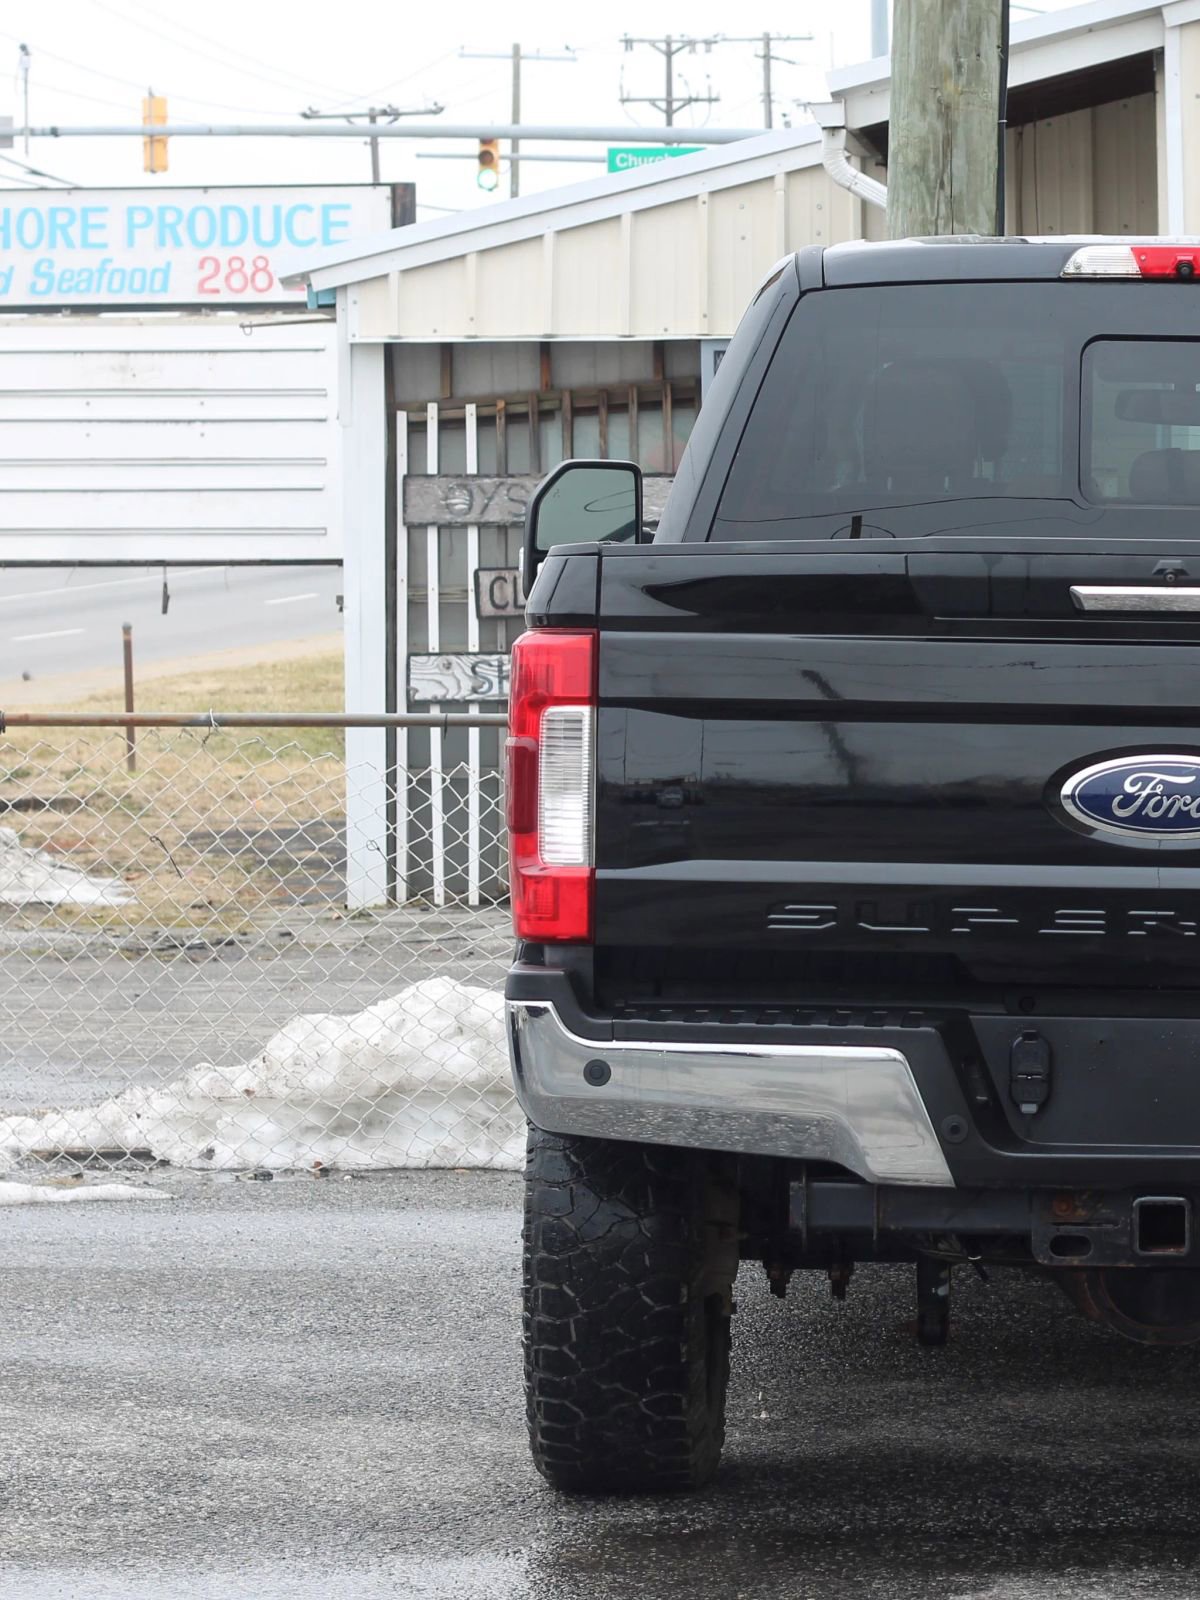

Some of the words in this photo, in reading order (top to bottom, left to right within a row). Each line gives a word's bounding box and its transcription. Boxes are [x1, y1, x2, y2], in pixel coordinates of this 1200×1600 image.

[616, 153, 671, 168] Chur
[126, 204, 352, 250] PRODUCE
[29, 257, 171, 296] Seafood
[765, 900, 1198, 936] SUPER
